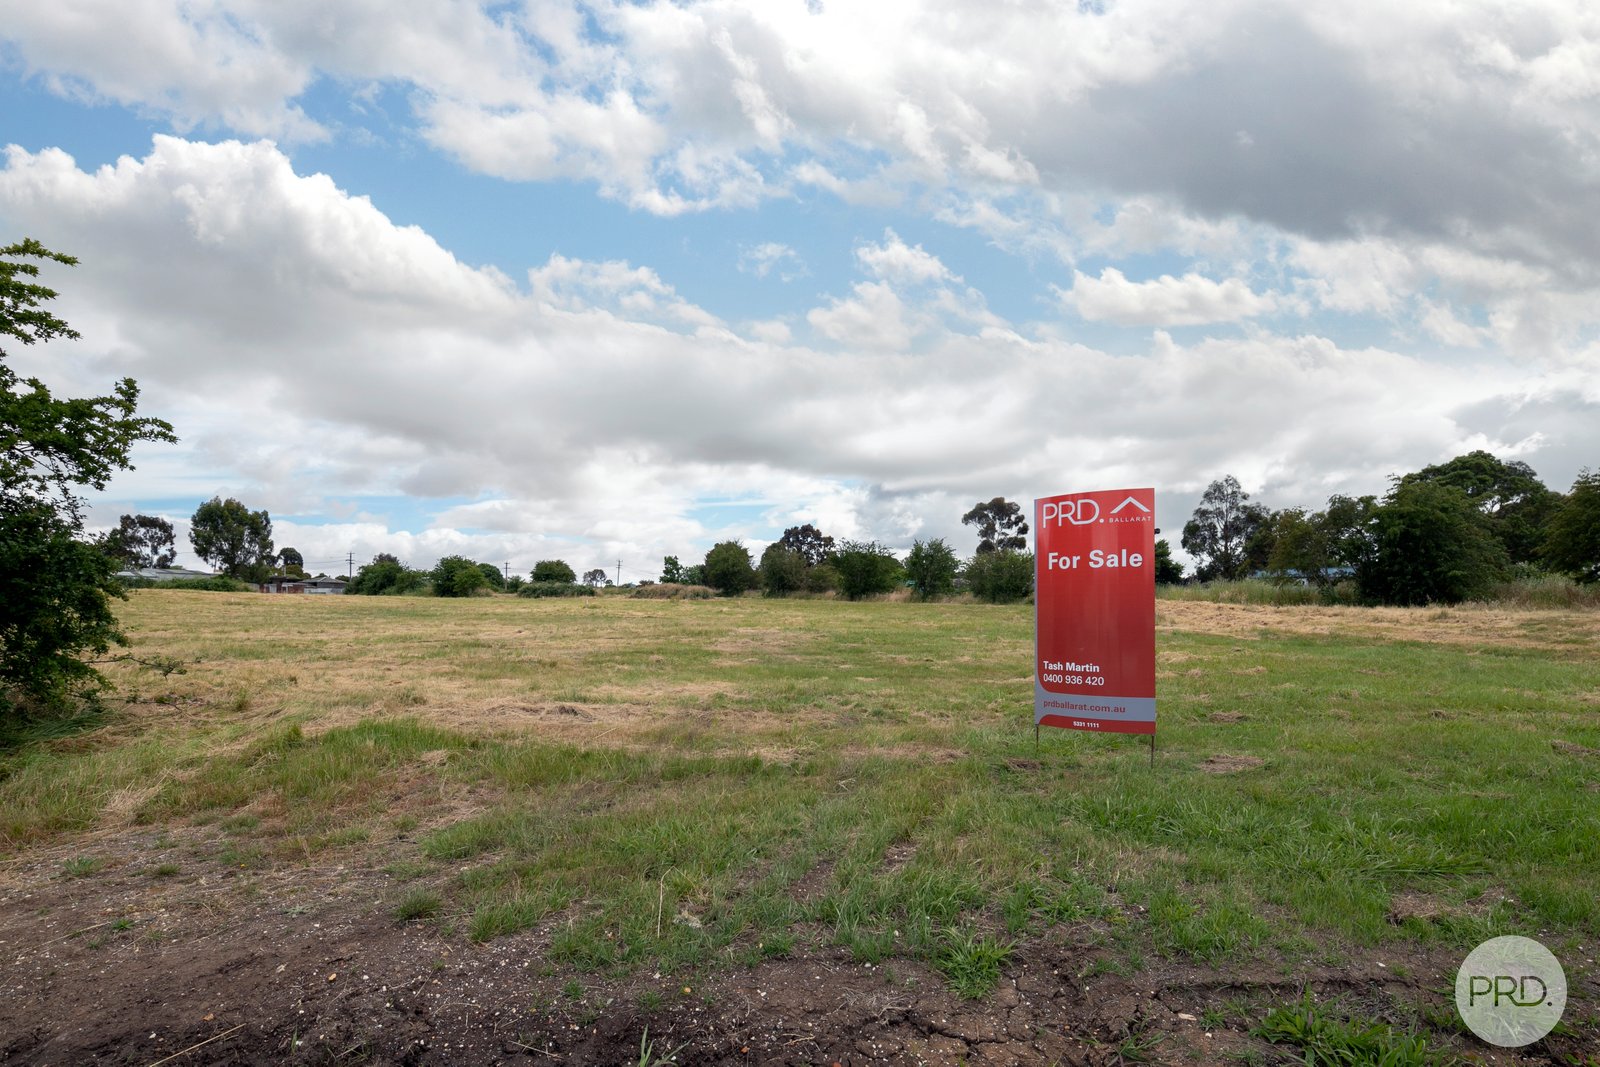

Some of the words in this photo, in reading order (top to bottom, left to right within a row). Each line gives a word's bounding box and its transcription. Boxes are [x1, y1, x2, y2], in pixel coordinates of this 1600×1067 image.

[1042, 499, 1105, 529] PRD.
[1048, 552, 1081, 570] For
[1089, 549, 1143, 568] Sale
[1043, 660, 1063, 671] Tash
[1065, 662, 1100, 673] Martin
[1043, 673, 1063, 683] 0400
[1065, 675, 1083, 685] 936
[1085, 676, 1105, 686] 420
[1043, 699, 1126, 713] prdballarat.com.au
